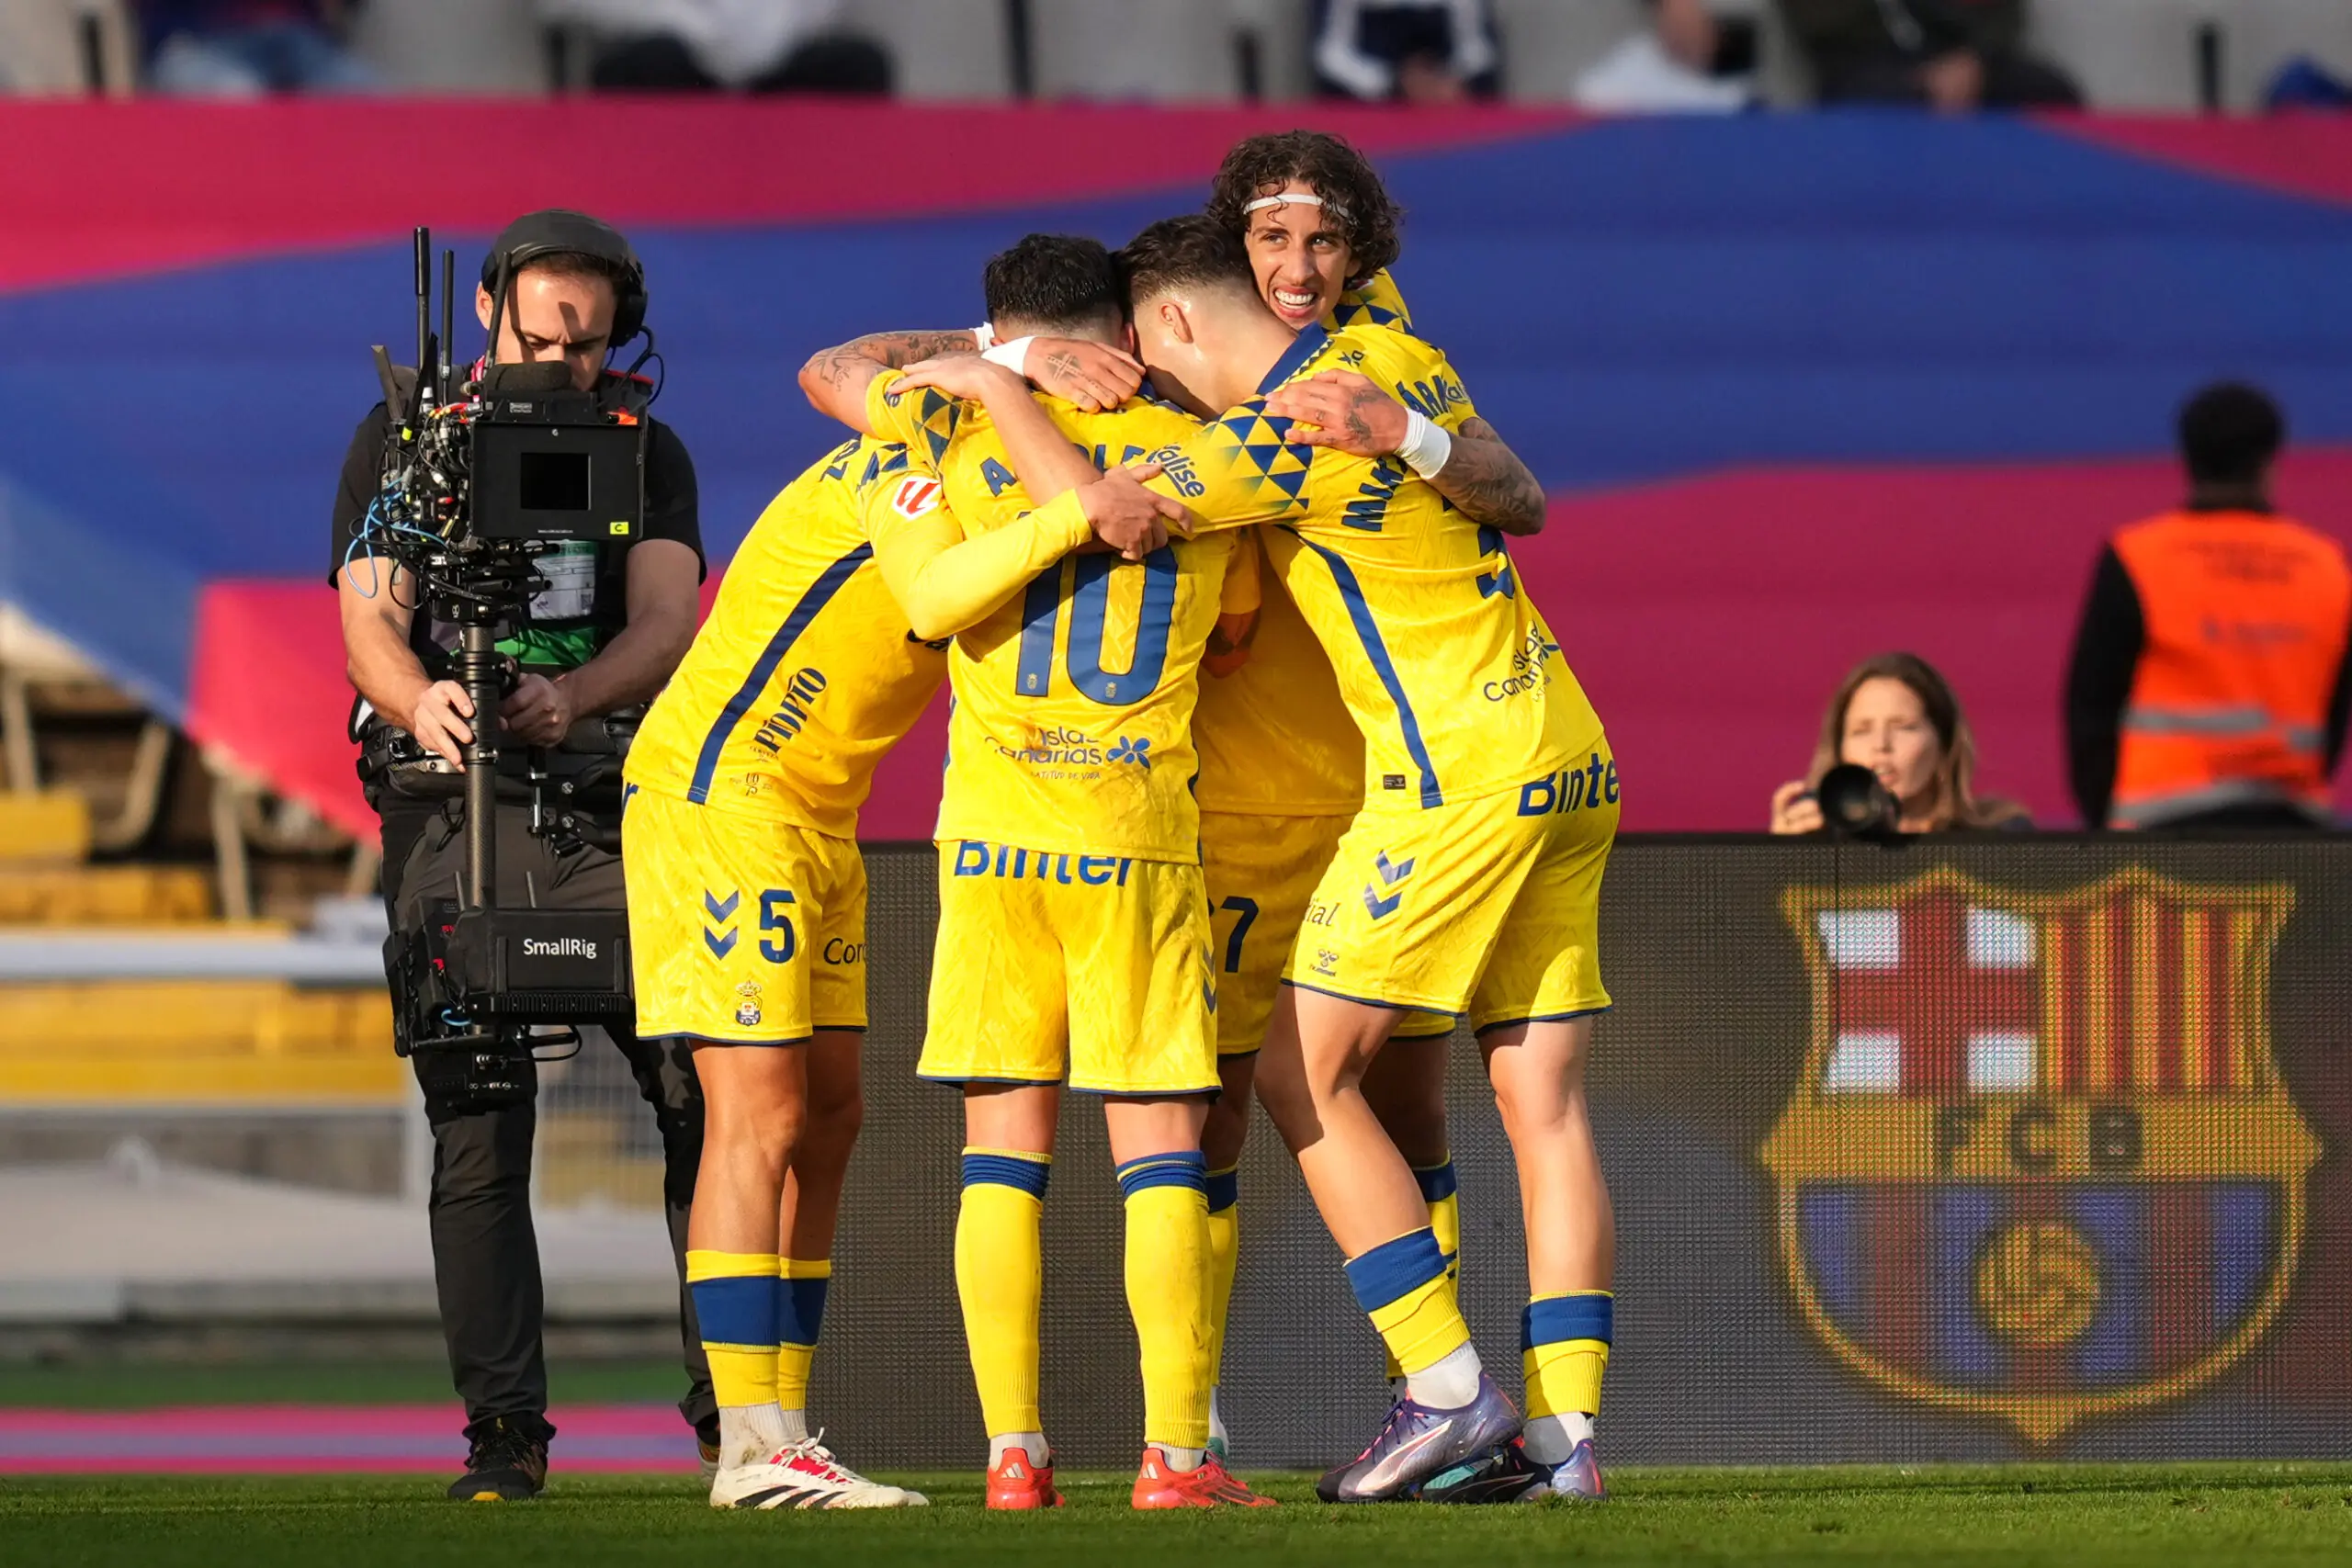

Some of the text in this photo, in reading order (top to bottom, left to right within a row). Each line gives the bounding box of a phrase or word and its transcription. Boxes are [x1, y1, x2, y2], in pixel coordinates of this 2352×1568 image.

[1014, 533, 1180, 706] 10
[954, 840, 1133, 887] Binter
[523, 937, 598, 960] SmallRig
[758, 888, 797, 964] 5
[1208, 895, 1260, 974] 7
